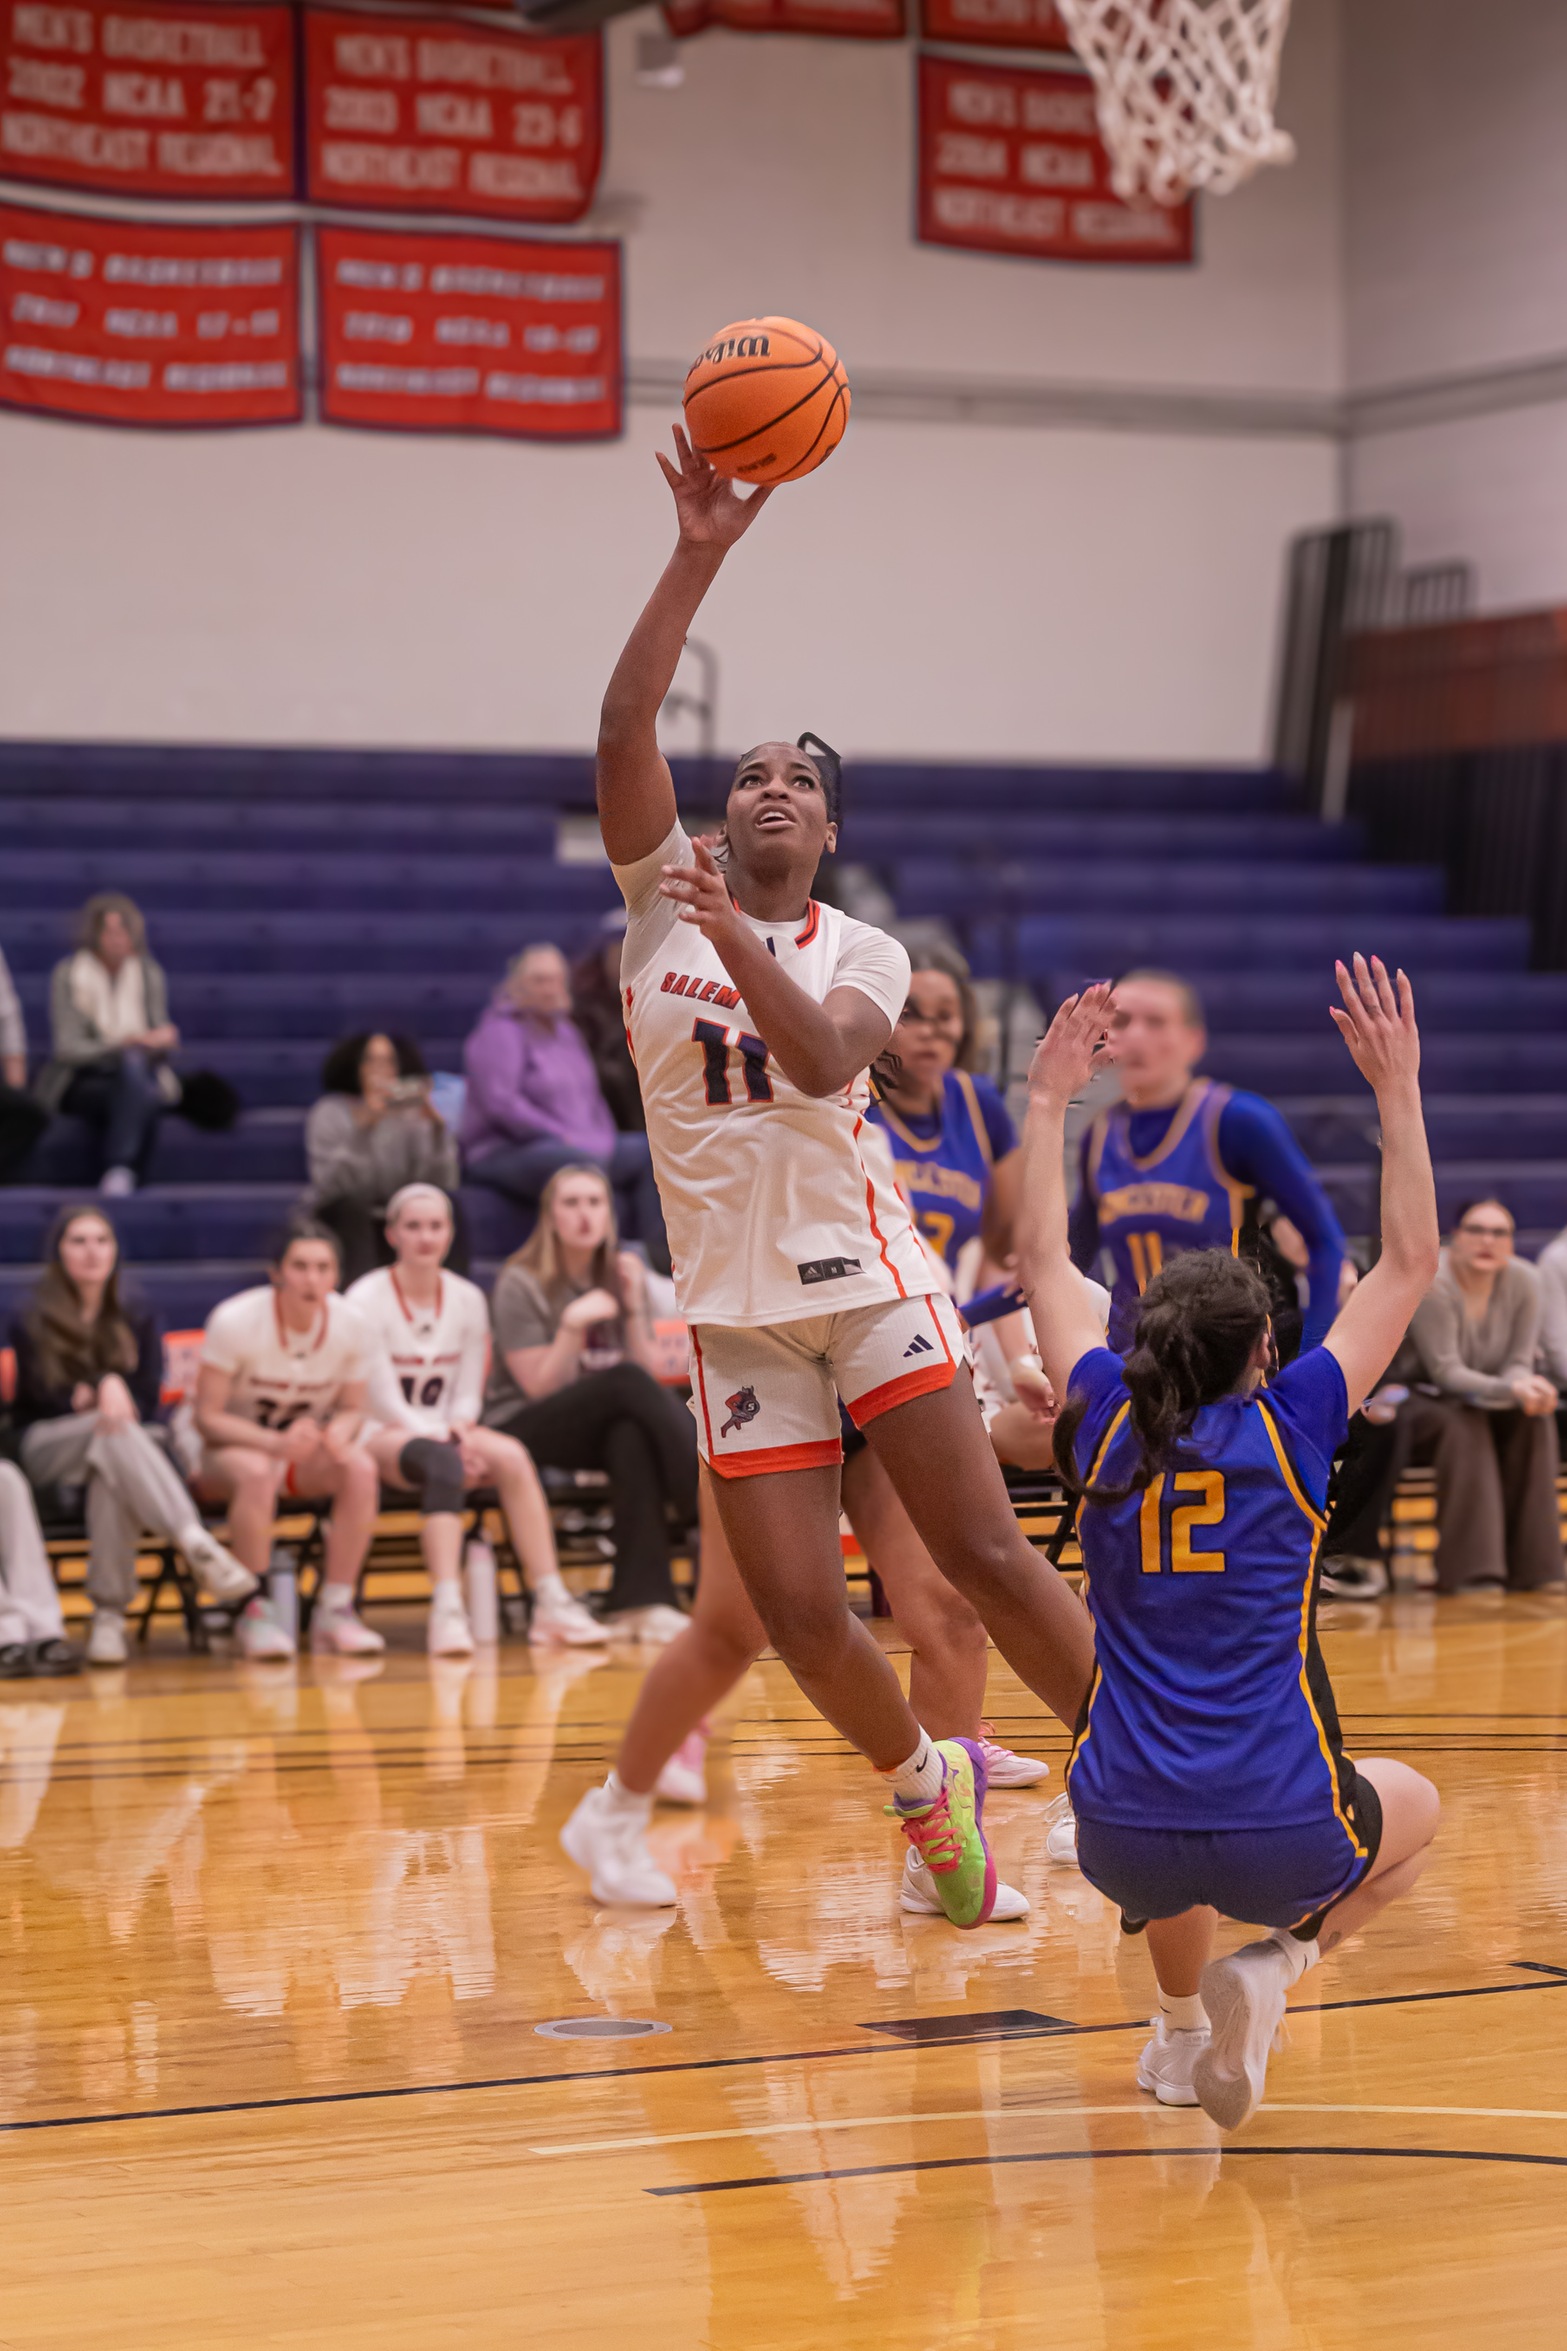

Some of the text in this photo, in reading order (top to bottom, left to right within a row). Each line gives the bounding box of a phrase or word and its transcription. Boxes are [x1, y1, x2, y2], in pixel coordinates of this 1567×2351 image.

[102, 14, 265, 68] BASKETBALL
[416, 38, 574, 95] BASKETBALL
[103, 71, 187, 118] NCAA
[416, 92, 493, 138] NCAA
[1, 111, 284, 176] NORTHEAST REGIONAL
[320, 140, 583, 200] NORTHEAST REGIONAL
[1020, 143, 1094, 187] NCAA
[660, 972, 741, 1011] SALEM
[691, 1017, 774, 1106] 11
[1140, 1470, 1225, 1573] 12
